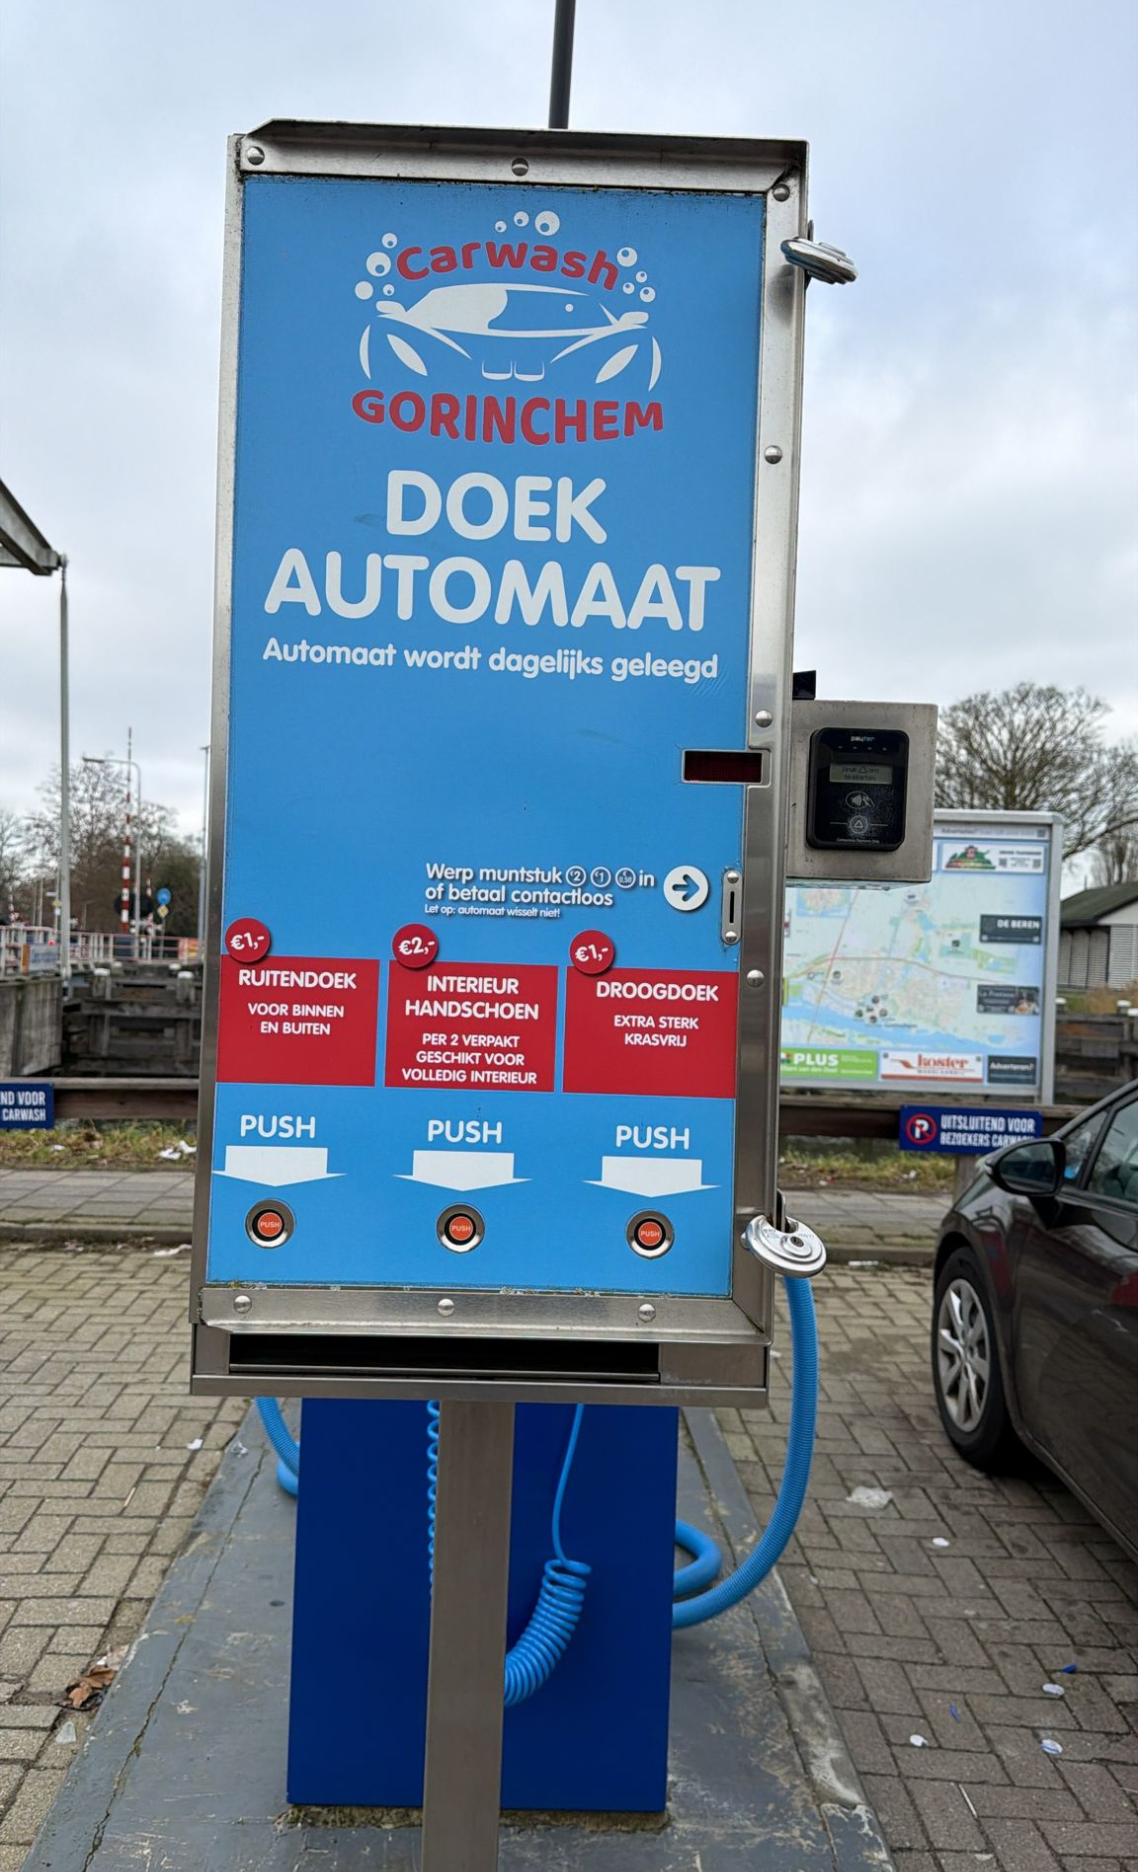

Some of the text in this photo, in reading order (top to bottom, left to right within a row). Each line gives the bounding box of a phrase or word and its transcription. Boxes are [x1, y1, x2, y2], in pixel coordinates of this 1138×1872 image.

[397, 240, 619, 290] Carwash
[352, 390, 664, 445] GORINCHEM
[386, 470, 607, 544] DOEK
[264, 548, 721, 631] AUTOMAAT
[263, 638, 718, 684] Automaat wordt dagelijks geleegd
[426, 863, 474, 884] Werp
[479, 866, 562, 884] muntstuk
[639, 870, 655, 887] in
[425, 884, 613, 906] of betaal contactloos
[425, 904, 561, 918] Let op: automaat wisselt niet!
[997, 919, 1040, 929] DE BEREN
[230, 932, 265, 950] €1,-
[398, 937, 435, 955] €2,-
[575, 944, 609, 962] €1,-
[238, 969, 357, 989] RUITENDOEK
[427, 975, 519, 995] INTERIEUR
[596, 981, 719, 1002] DROOGDOEK
[248, 1003, 344, 1018] VOOR BINNEN
[405, 1000, 539, 1020] HANDSCHOEN
[260, 1021, 330, 1035] EN BUITEN
[613, 1015, 699, 1030] EXTRA STERK
[422, 1033, 520, 1048] PER 2 VERPAKT
[624, 1033, 687, 1047] KRASVRIJ
[416, 1051, 524, 1066] GESCHIKT VOOR
[793, 1052, 838, 1067] PLUS
[402, 1068, 537, 1084] VOLLEDIG INTERIEUR
[17, 1091, 46, 1106] VOOR
[2, 1108, 46, 1121] CARWASH
[941, 1114, 1036, 1133] UITSLUITEND VOOR
[240, 1114, 316, 1139] PUSH
[427, 1119, 503, 1145] PUSH
[615, 1125, 690, 1151] PUSH
[940, 1132, 990, 1147] BEZOEKERS
[260, 1220, 281, 1229] PUSH
[452, 1224, 472, 1233] PUSH
[640, 1229, 661, 1238] PUSH
